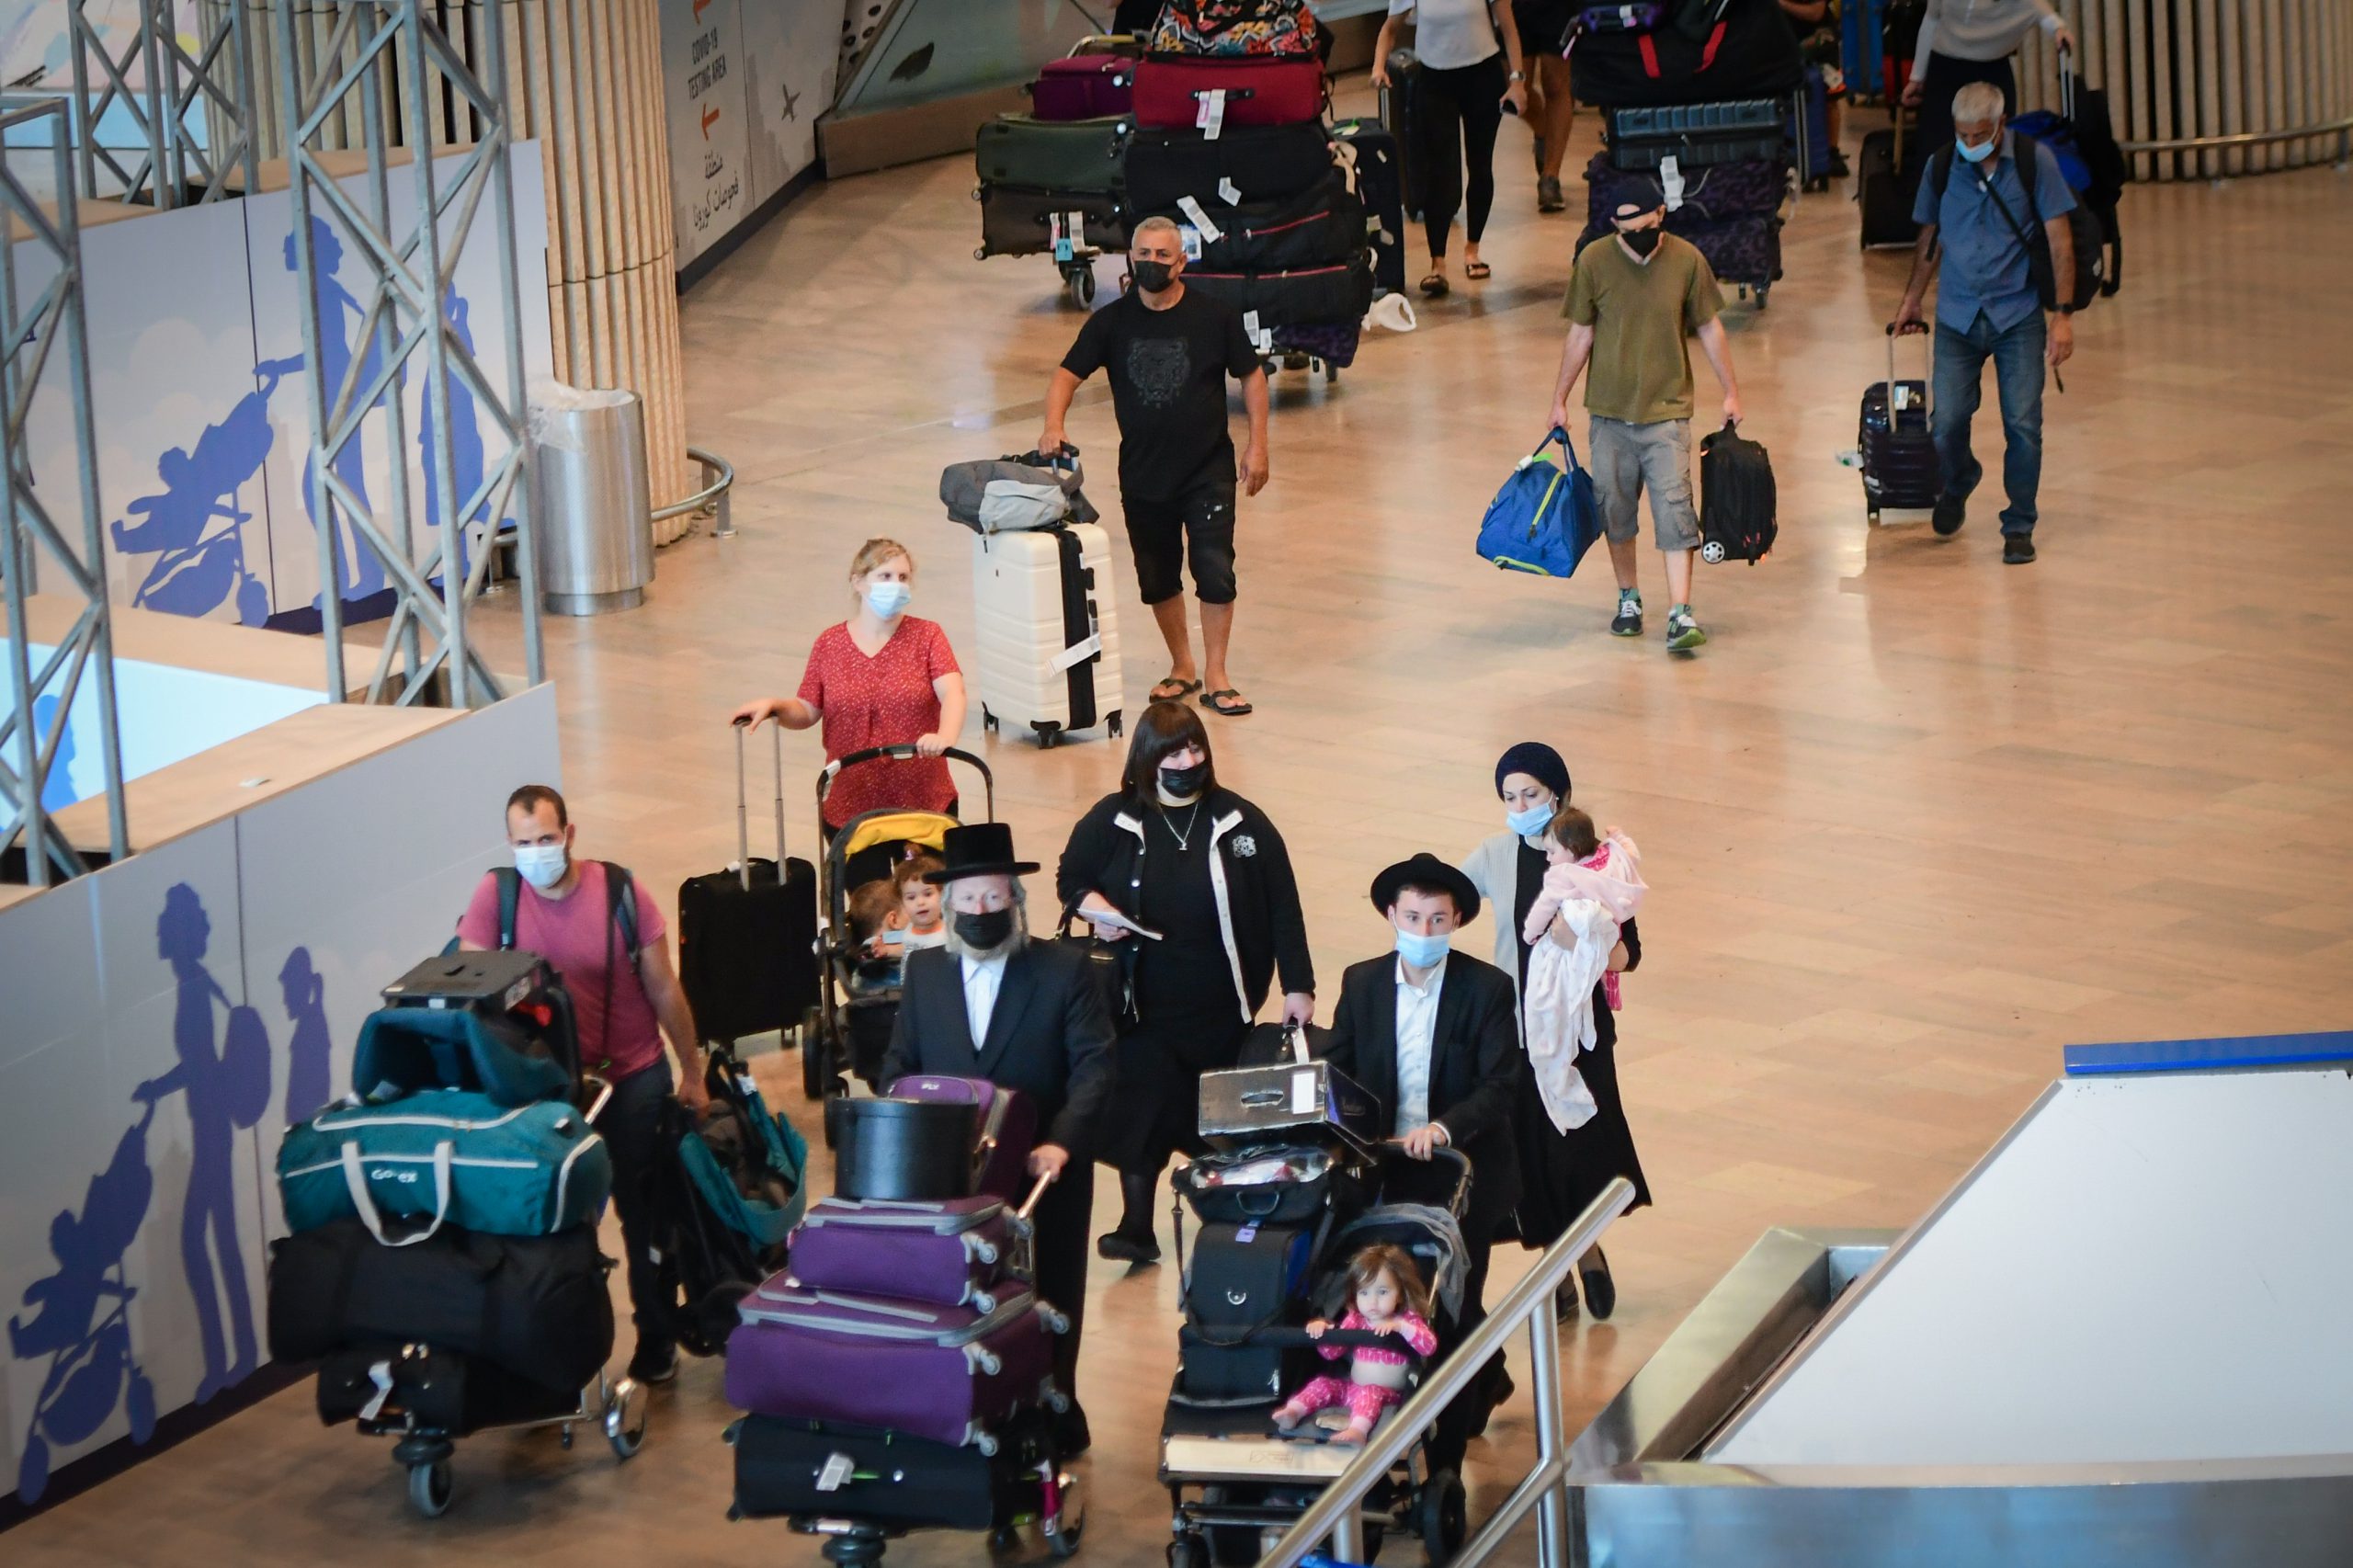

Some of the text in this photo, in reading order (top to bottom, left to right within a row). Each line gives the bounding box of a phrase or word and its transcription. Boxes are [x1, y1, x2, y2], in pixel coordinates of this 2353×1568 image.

[692, 26, 718, 65] COVID-19
[688, 53, 728, 100] TESTING AREA
